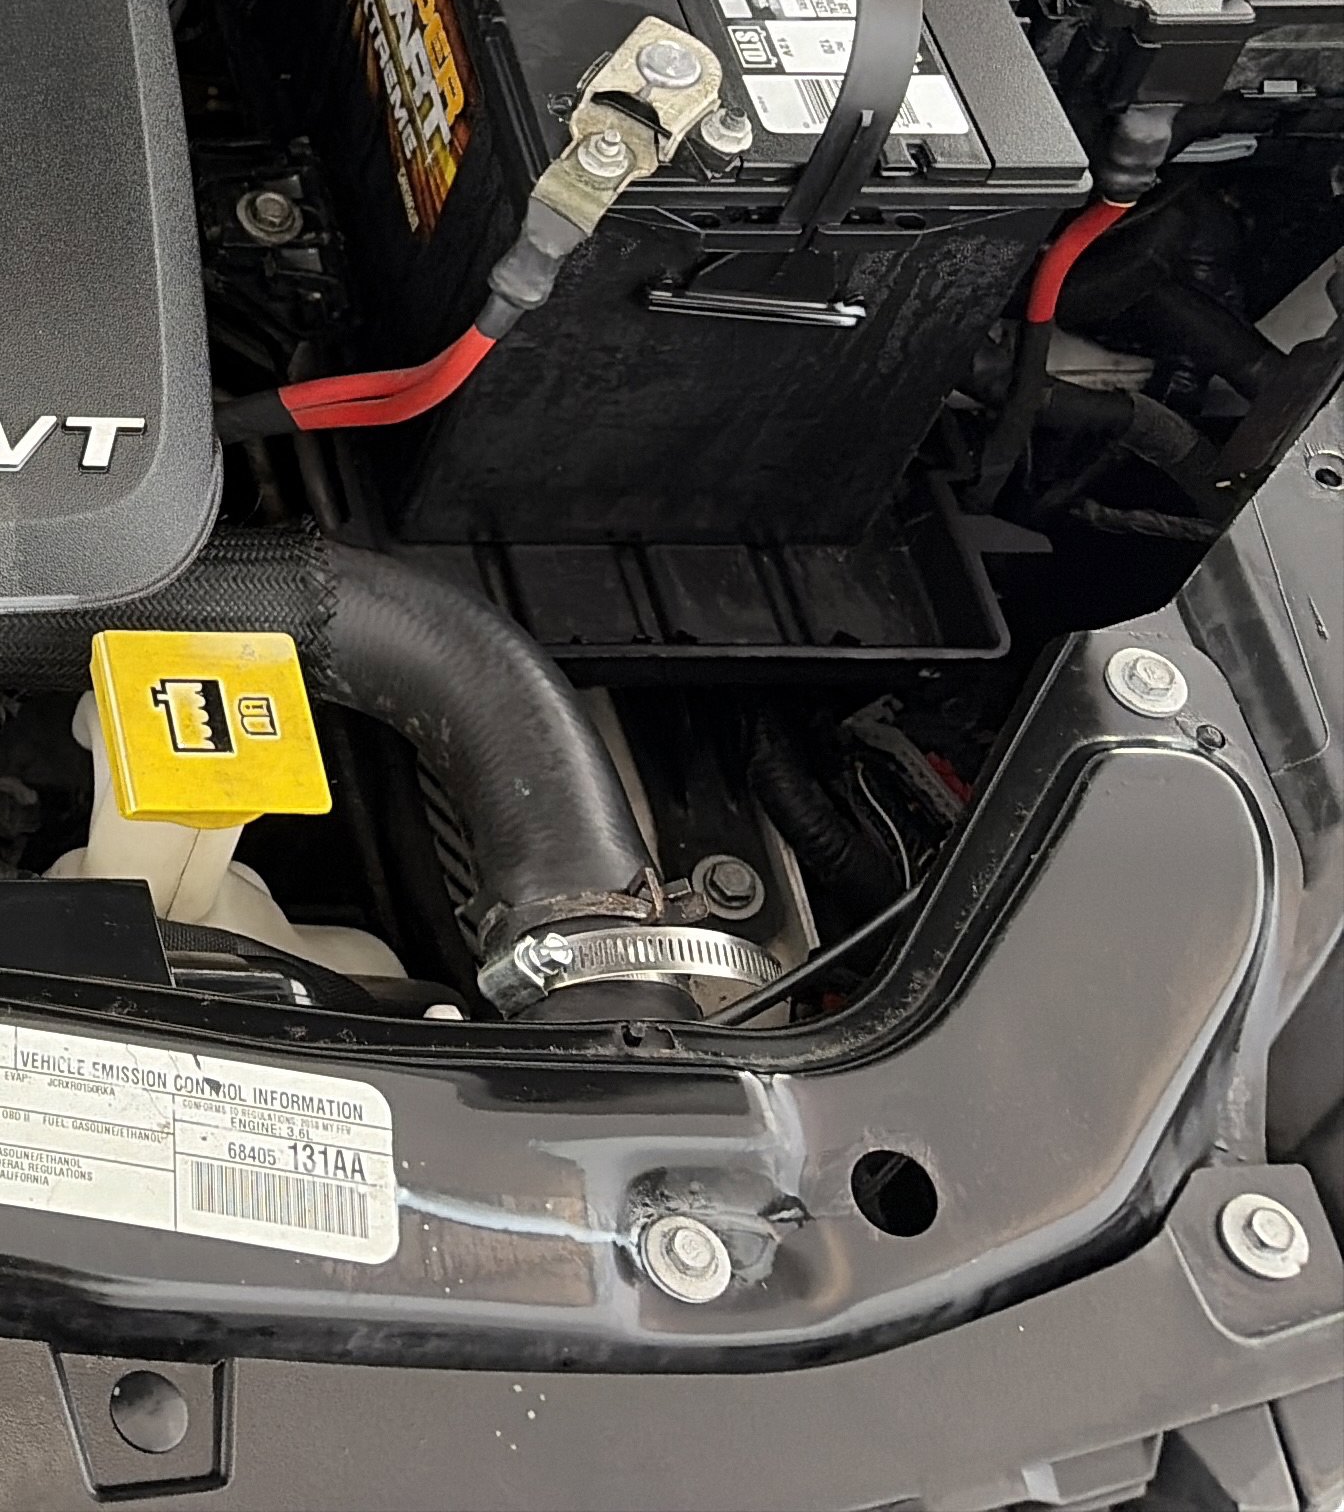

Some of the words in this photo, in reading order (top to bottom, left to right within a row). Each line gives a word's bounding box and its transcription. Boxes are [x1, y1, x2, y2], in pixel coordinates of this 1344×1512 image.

[733, 32, 765, 63] STD
[776, 38, 793, 57] 12V
[818, 40, 835, 55] 120
[4, 1071, 33, 1084] EVAP:
[20, 1050, 86, 1076] VEHICLE
[92, 1062, 167, 1089] EMISSION
[253, 1087, 363, 1121] INFORMATION
[2, 1108, 21, 1121] OBD
[42, 1115, 70, 1129] FUEL:
[72, 1120, 162, 1144] GASOLINE/ETHANOL
[182, 1099, 226, 1114] CONFORMS
[230, 1107, 239, 1116] TO
[322, 1122, 334, 1133] MY
[230, 1117, 282, 1136] ENGINE:
[286, 1126, 313, 1140] 3.6L
[28, 1162, 93, 1182] REGULATIONS
[228, 1141, 277, 1166] 68405
[288, 1142, 367, 1182] 131AA
